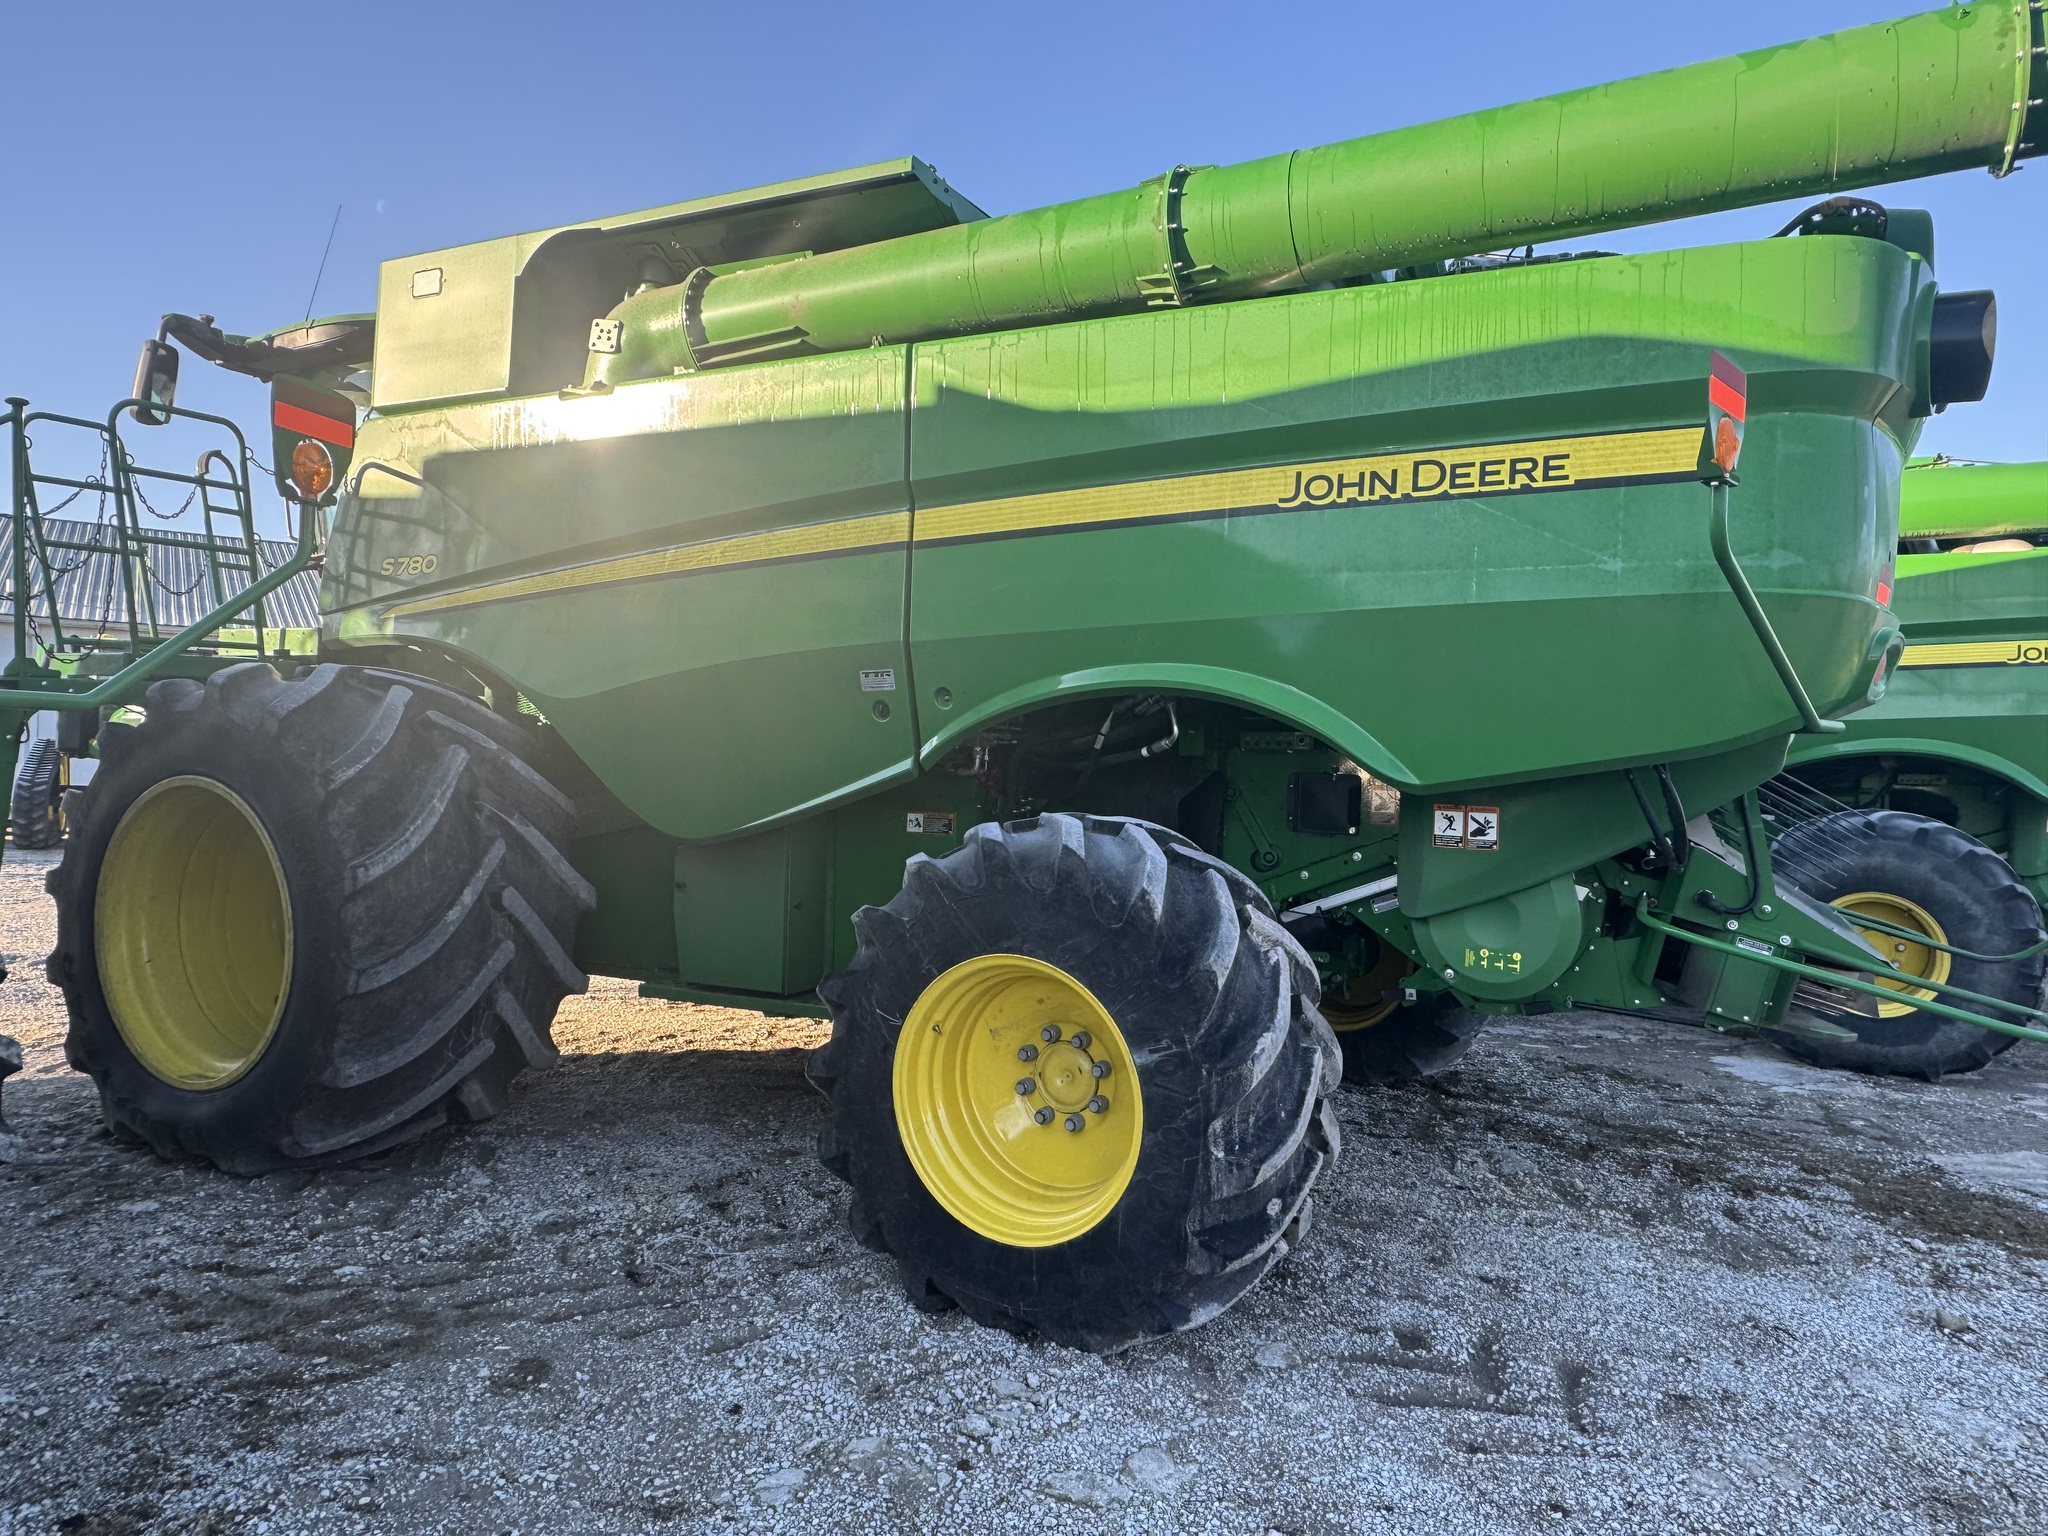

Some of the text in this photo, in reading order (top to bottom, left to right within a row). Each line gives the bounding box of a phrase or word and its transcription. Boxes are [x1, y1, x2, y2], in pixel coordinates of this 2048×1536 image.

[1278, 453, 1571, 505] JOHN DEERE
[380, 553, 438, 577] S780
[2006, 644, 2048, 663] JO
